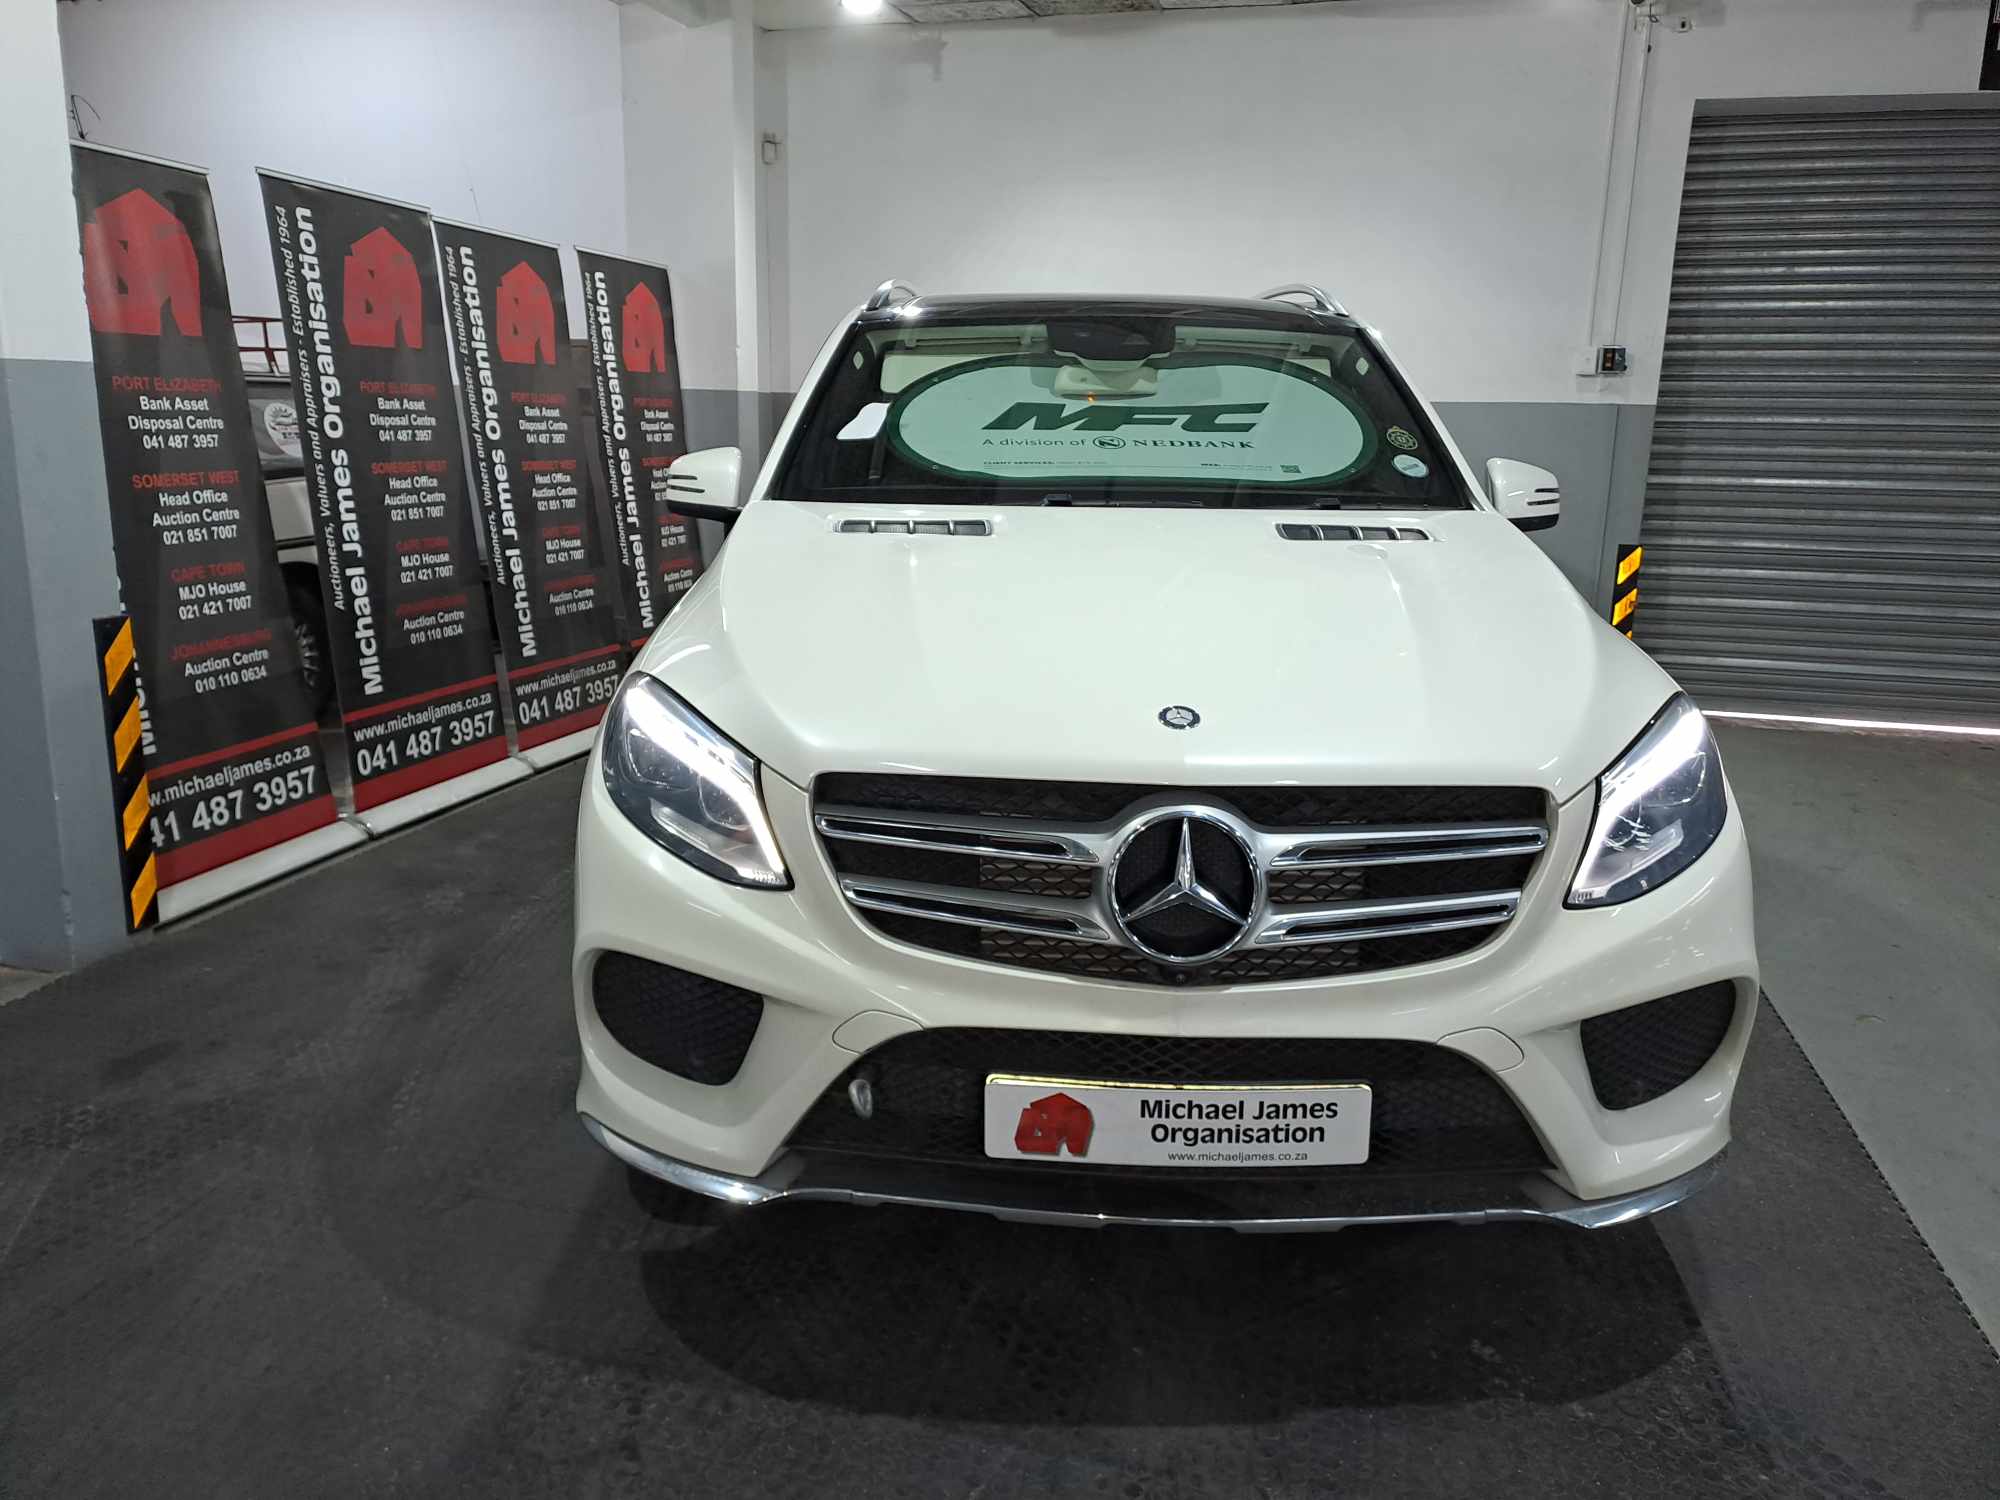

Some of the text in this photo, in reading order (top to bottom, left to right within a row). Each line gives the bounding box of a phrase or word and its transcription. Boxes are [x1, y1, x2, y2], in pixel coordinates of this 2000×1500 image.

[449, 278, 469, 356] Established
[139, 396, 209, 411] Bank Asset
[275, 205, 346, 612] Auctioneers, Valuers and Appraisers Established 1964
[377, 397, 401, 410] Bank
[464, 364, 482, 432] Appraisers
[128, 415, 224, 432] Disposal Centre
[369, 413, 409, 429] Disposal
[981, 401, 1270, 432] MFC
[143, 434, 219, 449] 041 487 3957
[378, 430, 395, 441] 041
[982, 438, 1254, 449] A division of NEDBANK
[294, 205, 384, 696] Michael James Organisation
[459, 246, 537, 658] Michael James Organisation
[472, 433, 487, 464] and
[593, 271, 654, 629] Michael James Organisation
[132, 470, 240, 489] SOMERSET WEST
[389, 475, 438, 490] Head Office
[479, 463, 493, 507] Valuers
[609, 457, 619, 498] Valuers
[159, 489, 228, 507] Head Office
[384, 494, 418, 506] Auction
[152, 508, 240, 527] Auction Centre
[391, 508, 407, 521] 021
[408, 507, 424, 519] 851
[163, 525, 237, 545] 021 851 7007
[401, 552, 450, 567] MJO House
[400, 571, 416, 584] 021
[418, 568, 433, 580] 421
[179, 580, 247, 601] MJO House
[179, 595, 253, 620] 021 421 7007
[403, 615, 436, 630] Auction
[410, 632, 426, 645] 010
[427, 628, 442, 641] 110
[184, 649, 269, 677] Auction Centre
[195, 664, 268, 694] 010 110 0634
[518, 674, 620, 725] 041 487 3957
[353, 692, 492, 743] www.michaeljames.co.za
[356, 710, 496, 777] 041 487 3957
[191, 790, 245, 831] 487
[252, 765, 316, 812] 3957
[1139, 1099, 1339, 1121] Michael James
[1150, 1122, 1326, 1146] Organisation
[1167, 1151, 1309, 1163] www.michaeljames.co.za
